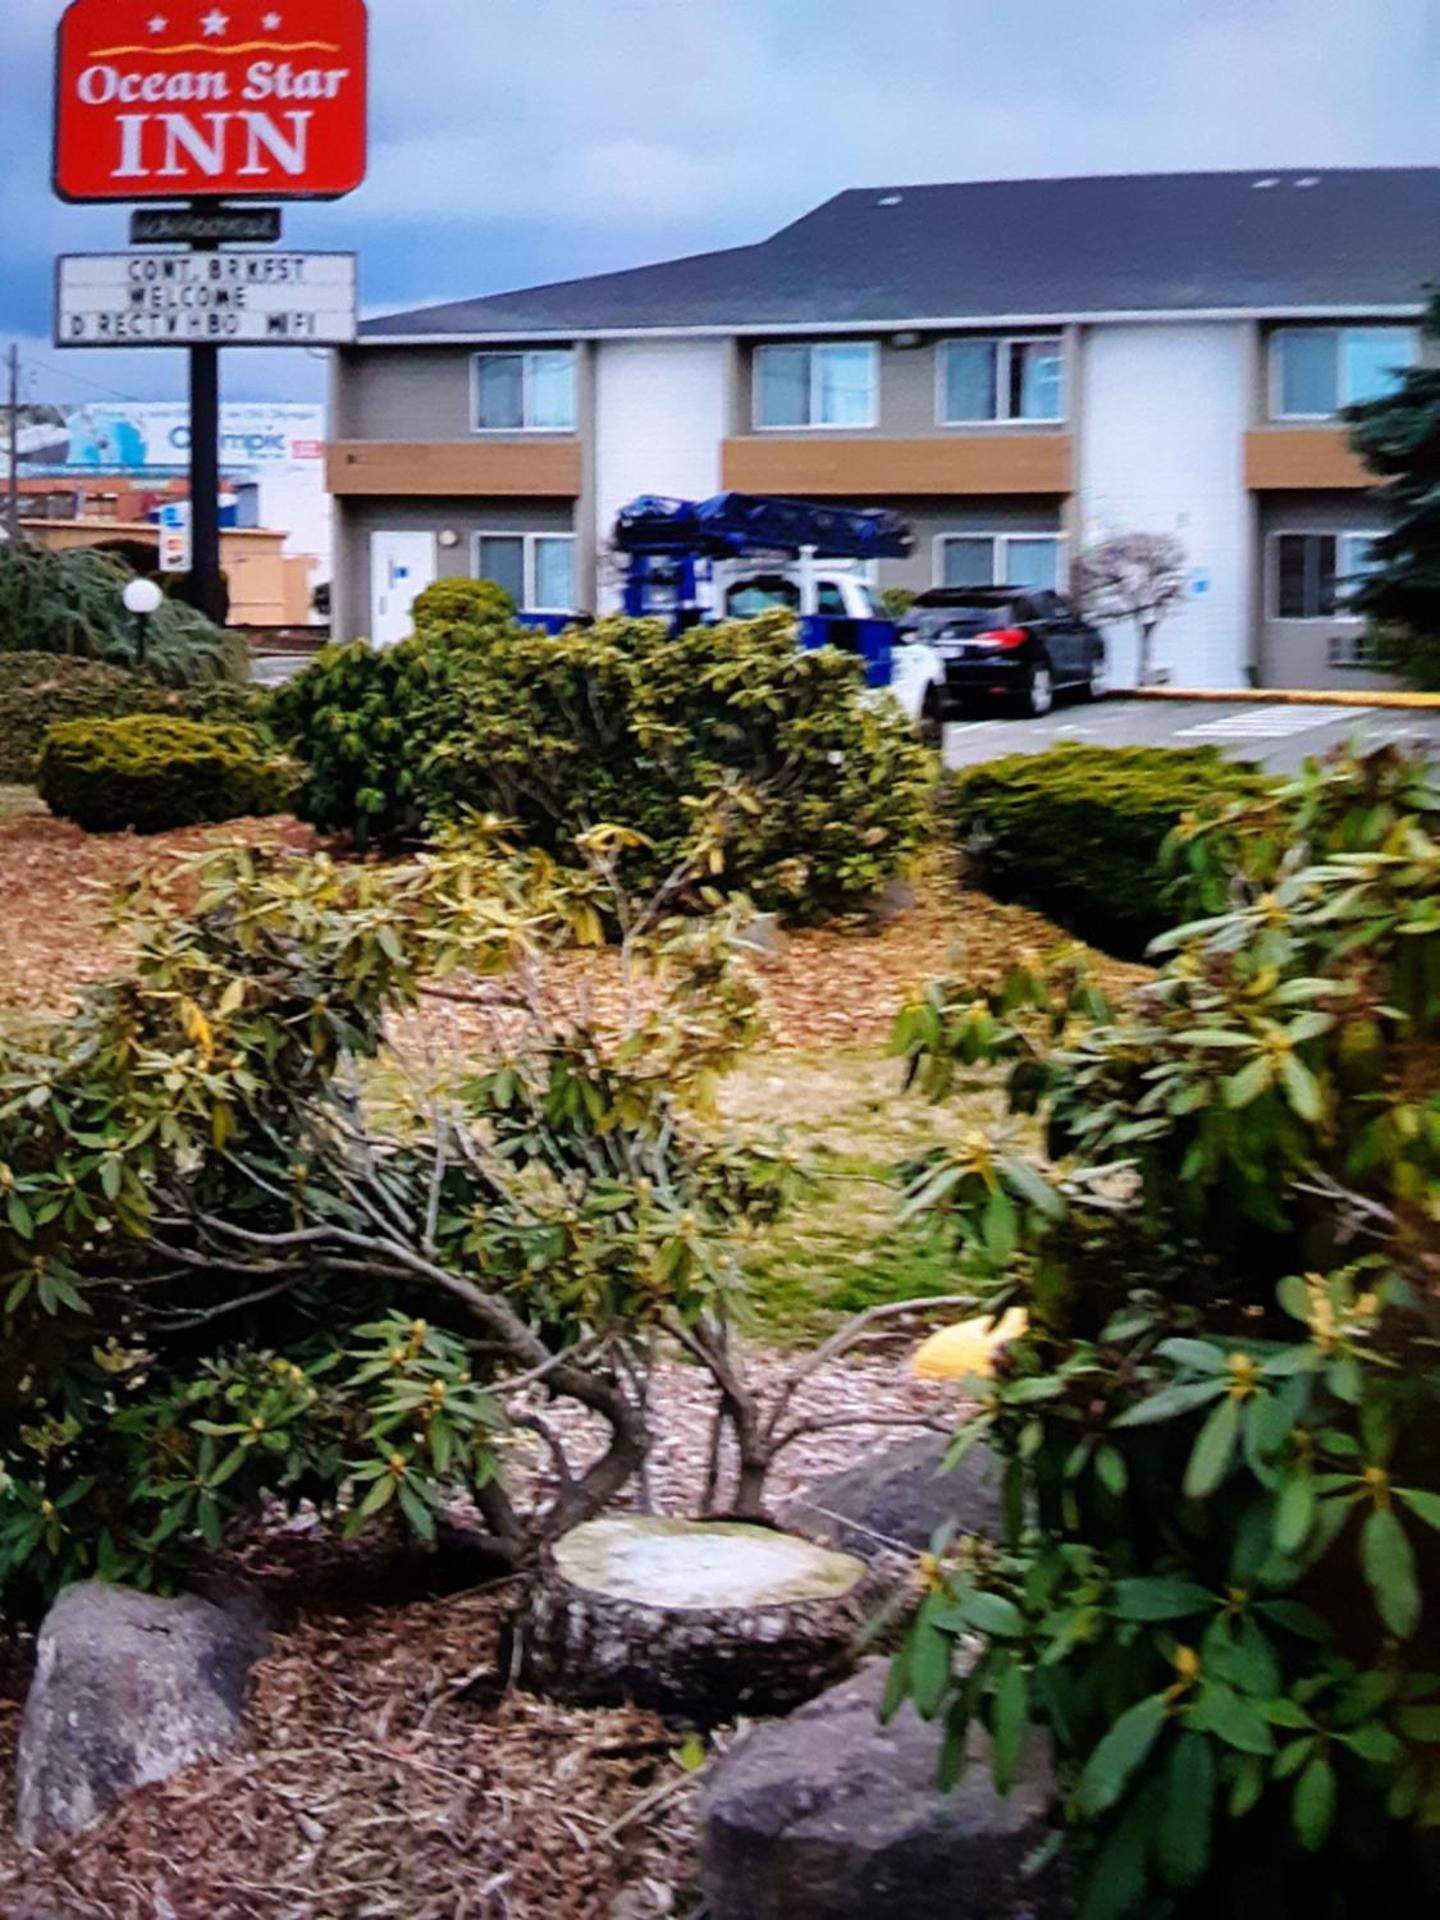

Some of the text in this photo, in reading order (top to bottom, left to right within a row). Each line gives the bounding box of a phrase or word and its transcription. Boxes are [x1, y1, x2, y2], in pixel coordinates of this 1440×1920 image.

[77, 61, 348, 104] Ocean Star
[109, 110, 314, 177] INN
[129, 285, 246, 308] WELCOME
[70, 314, 178, 336] DRECTV
